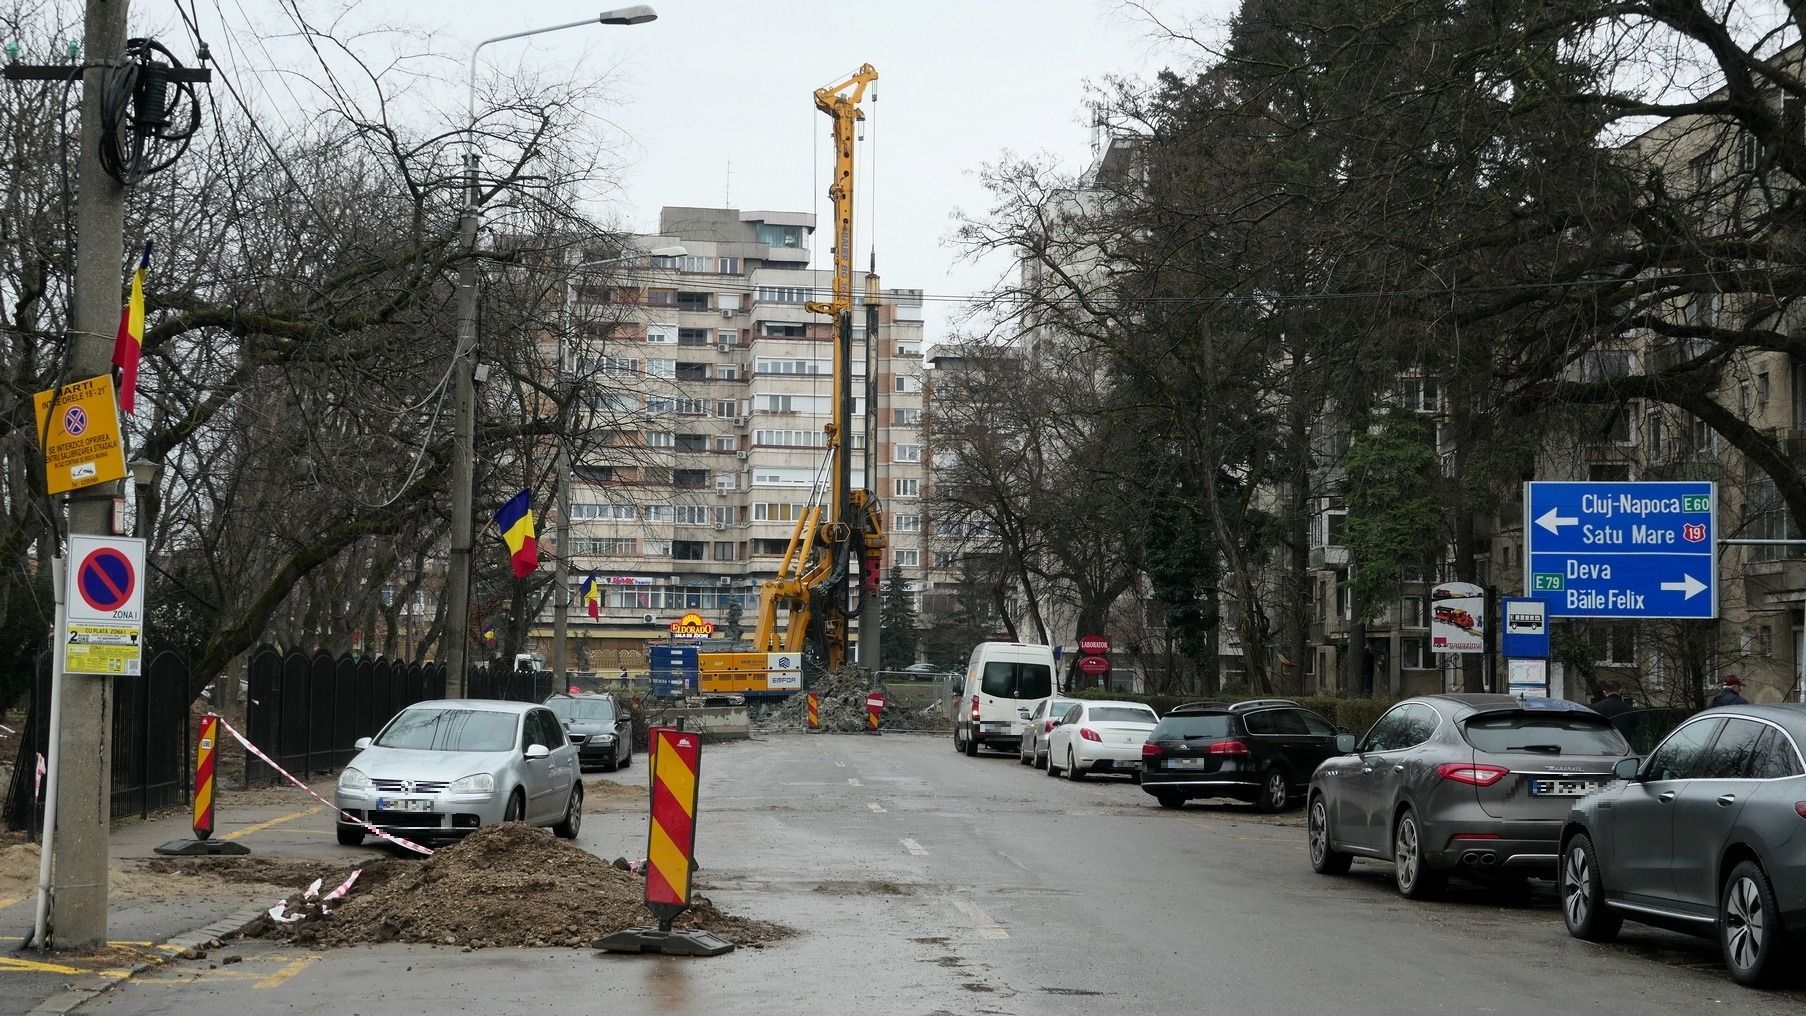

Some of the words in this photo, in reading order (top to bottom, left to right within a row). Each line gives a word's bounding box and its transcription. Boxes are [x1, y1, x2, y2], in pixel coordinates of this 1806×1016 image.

[62, 392, 84, 404] ORELE
[1582, 494, 1680, 518] Cluj-Napoca
[1583, 524, 1622, 544] Satu
[1632, 525, 1675, 544] Mare
[1688, 528, 1701, 540] 19
[1567, 560, 1611, 579] Deva
[1567, 589, 1605, 609] Băile
[1608, 590, 1645, 610] Felix
[112, 610, 134, 619] ZONA
[69, 630, 78, 642] 2
[672, 623, 712, 634] ELDORADO
